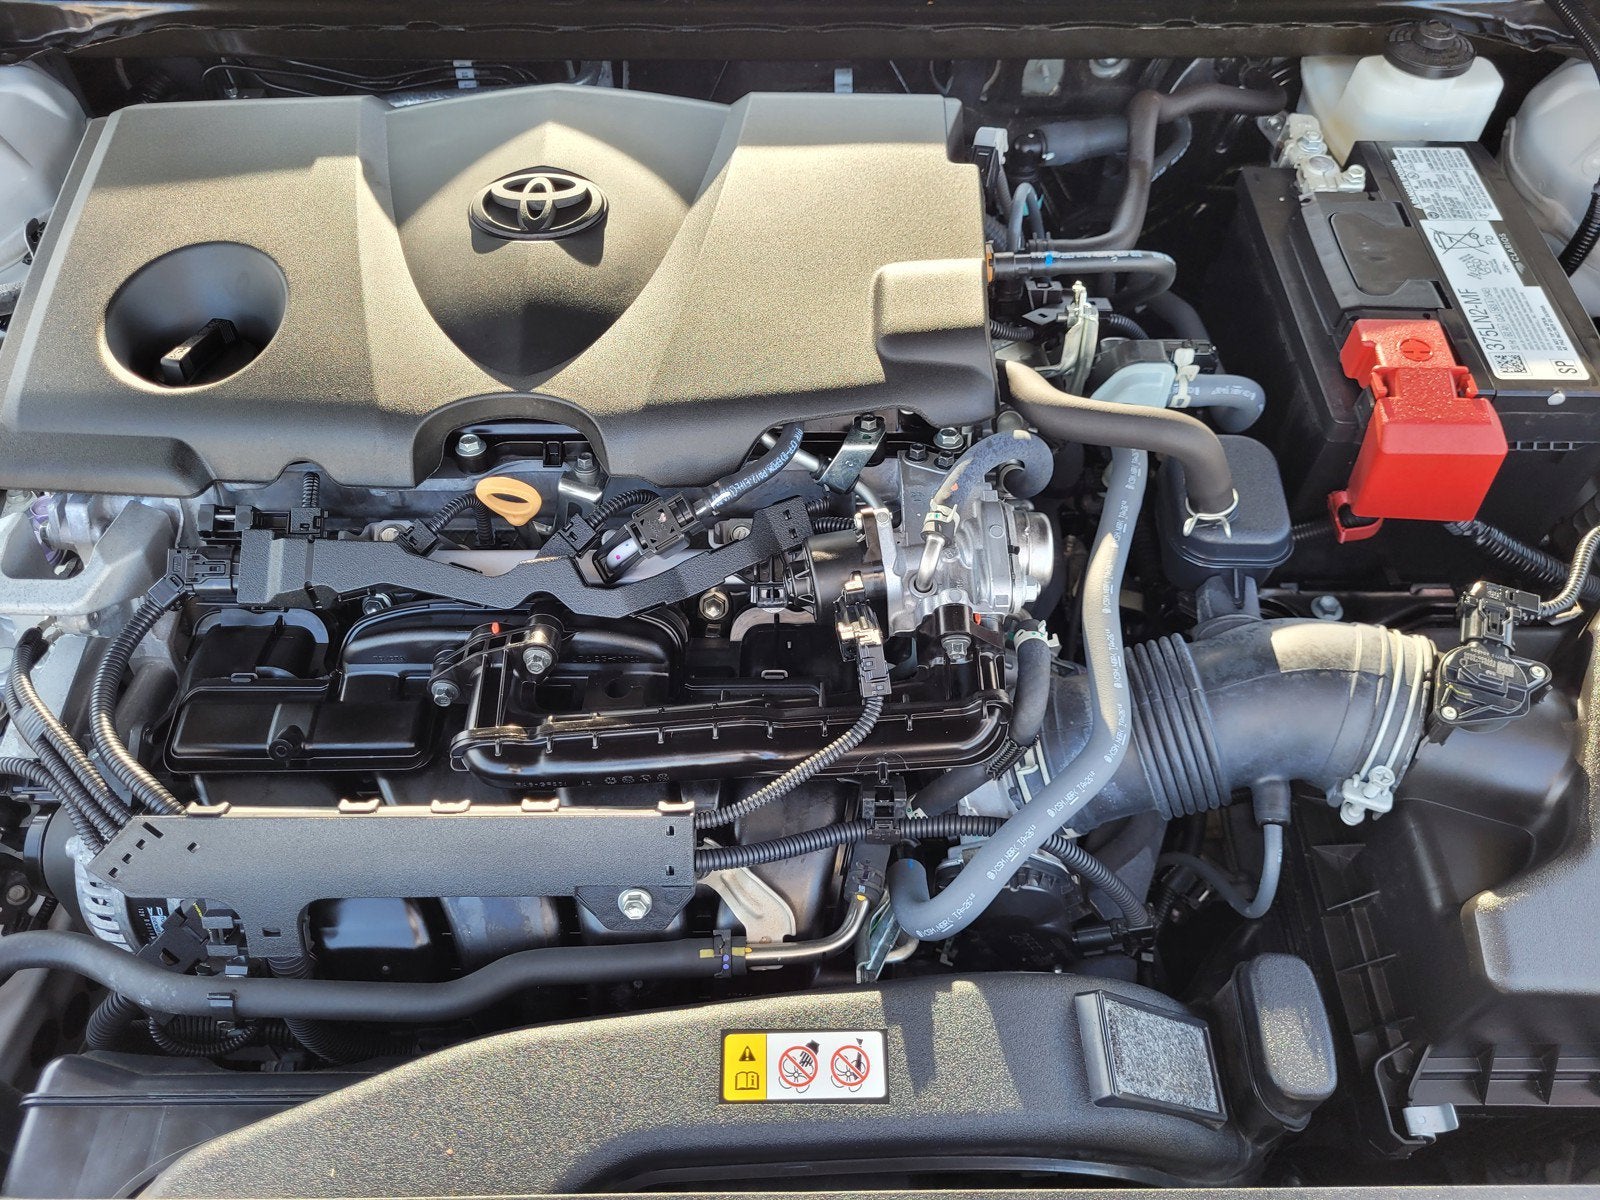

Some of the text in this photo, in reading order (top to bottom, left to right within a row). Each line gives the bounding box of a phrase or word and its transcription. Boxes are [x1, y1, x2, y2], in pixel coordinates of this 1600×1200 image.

[1485, 234, 1498, 246] Pb
[1499, 232, 1520, 263] CLARIOS
[1458, 288, 1506, 351] 375LN2-MF
[1555, 360, 1578, 375] SP
